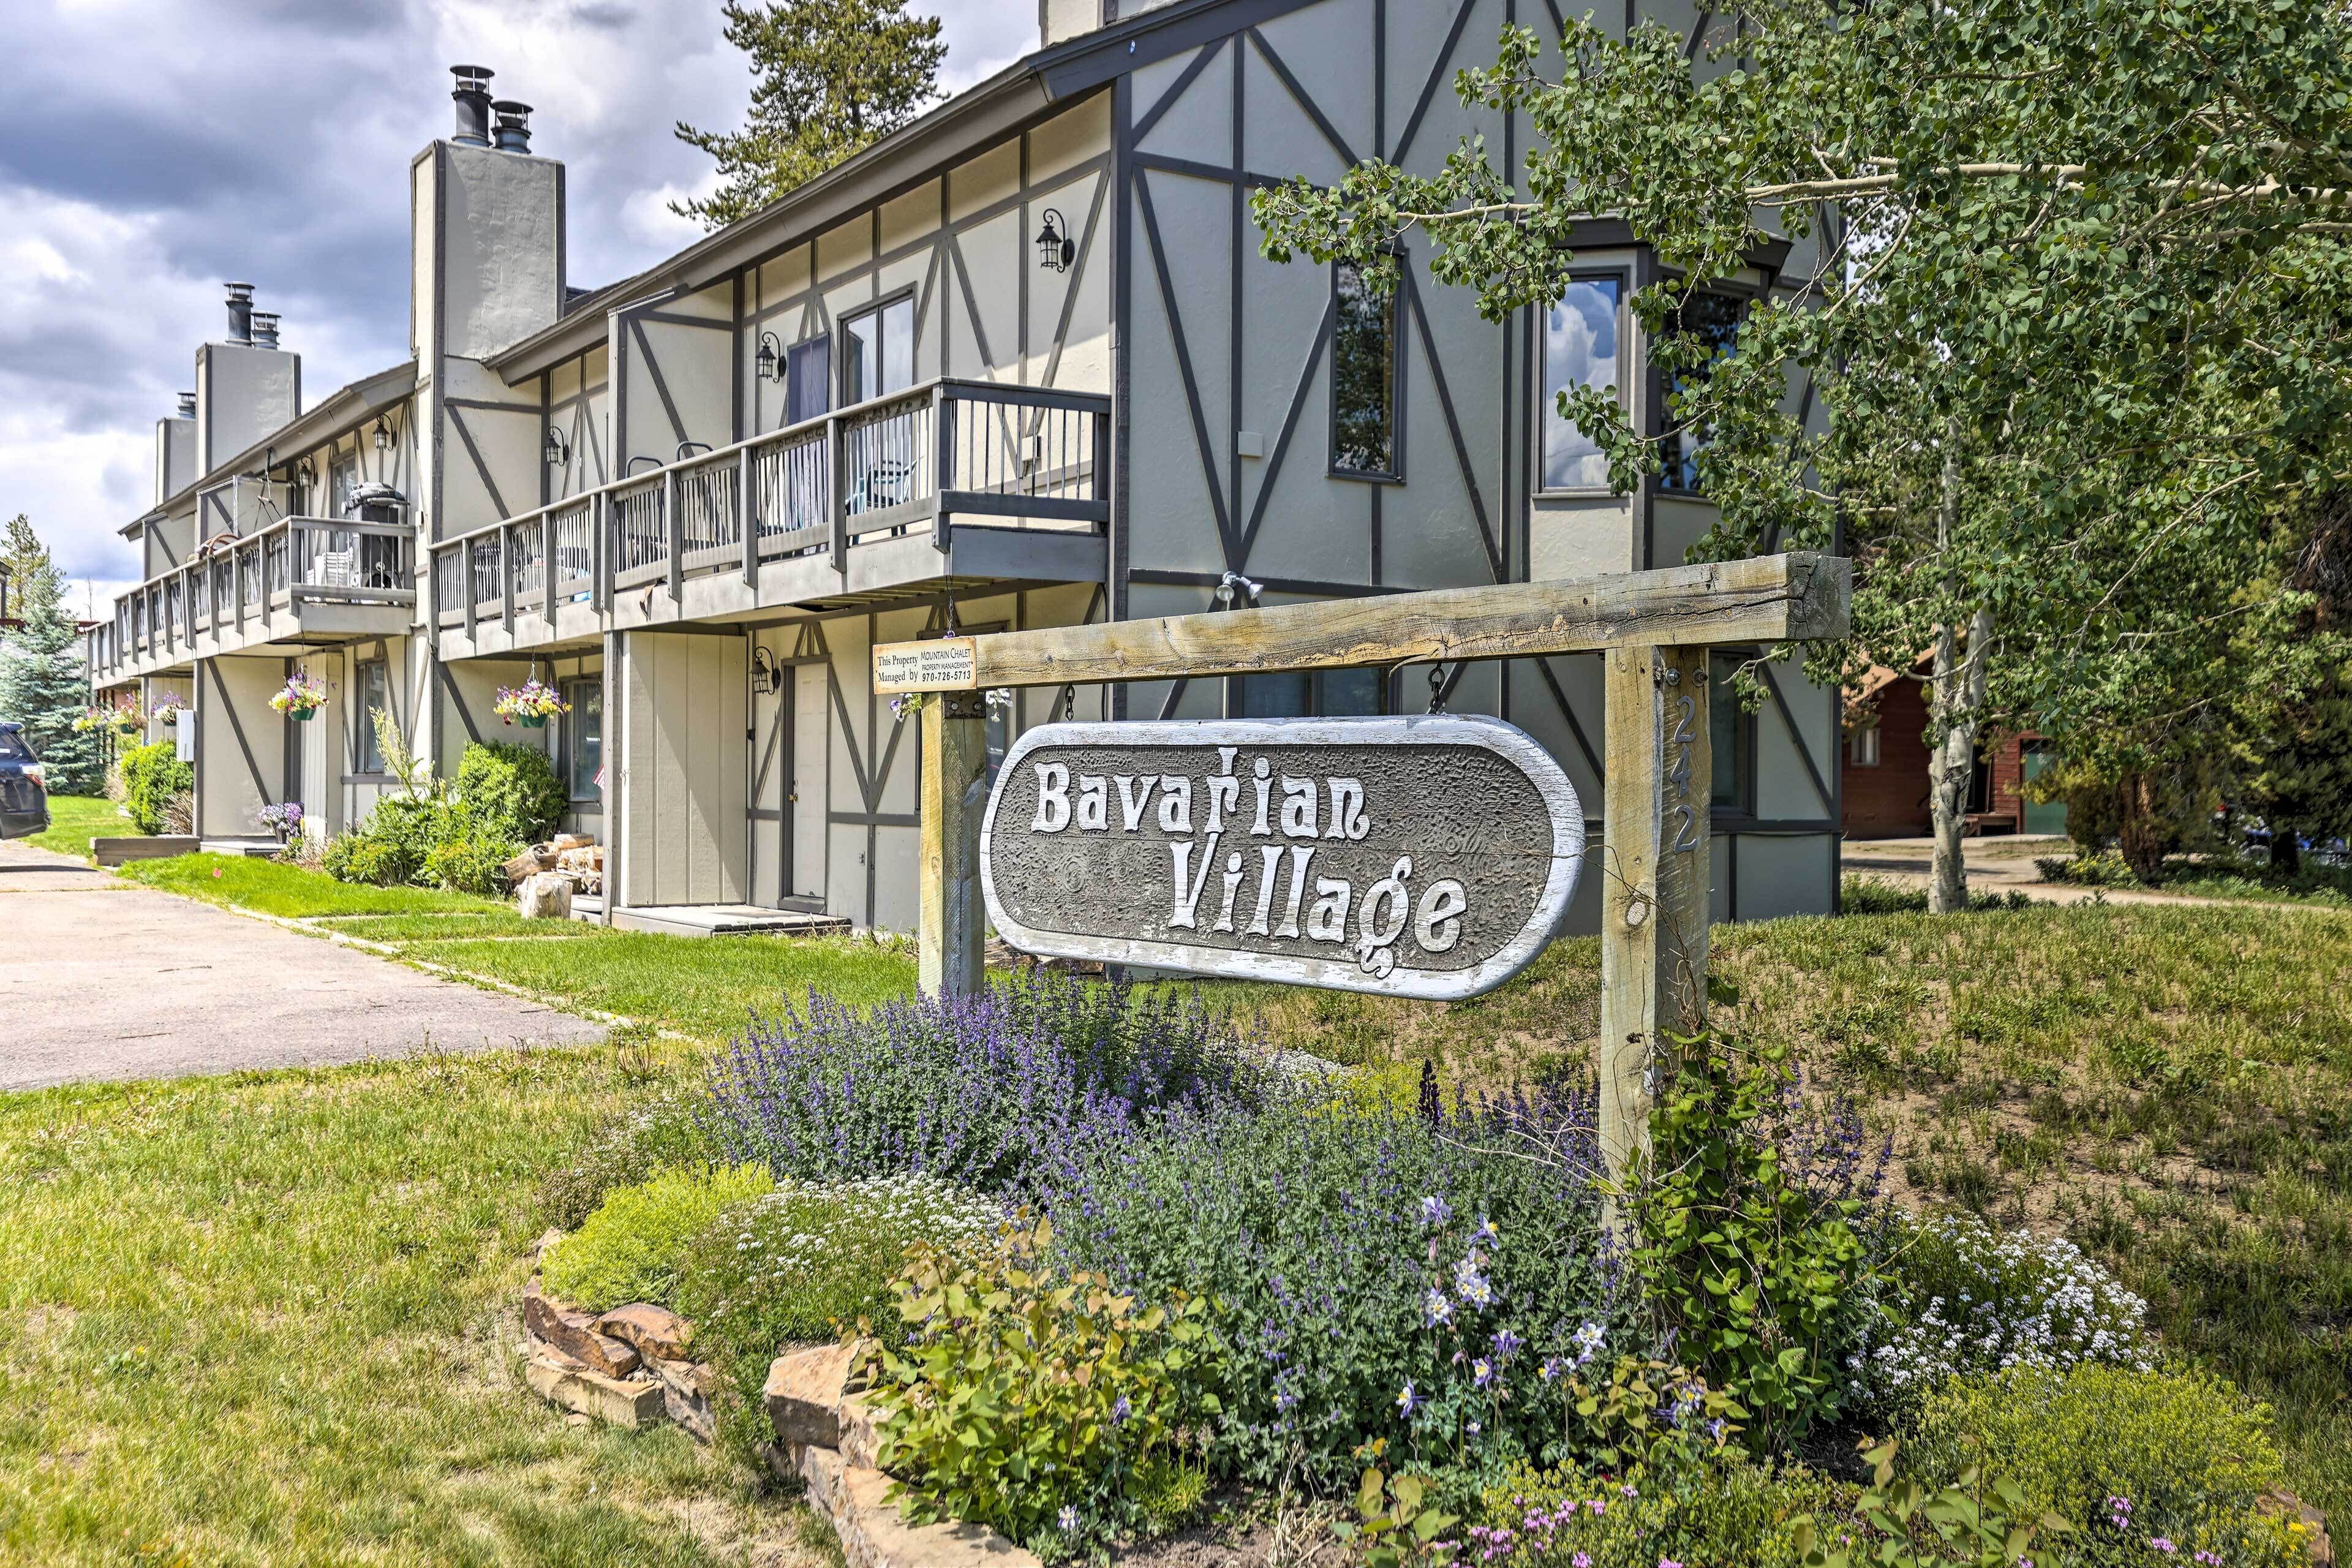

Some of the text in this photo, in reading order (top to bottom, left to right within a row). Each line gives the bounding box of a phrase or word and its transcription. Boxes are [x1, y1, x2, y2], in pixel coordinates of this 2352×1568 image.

[921, 647, 971, 660] MOUNTAIN CHALET
[878, 655, 918, 668] This Property
[941, 661, 970, 669] MANAGEMENT
[878, 668, 918, 684] Managed by
[922, 670, 971, 682] 970-726-5713
[1670, 695, 1697, 854] 242
[1030, 746, 1371, 841] Bavarian
[1167, 832, 1468, 979] Village
